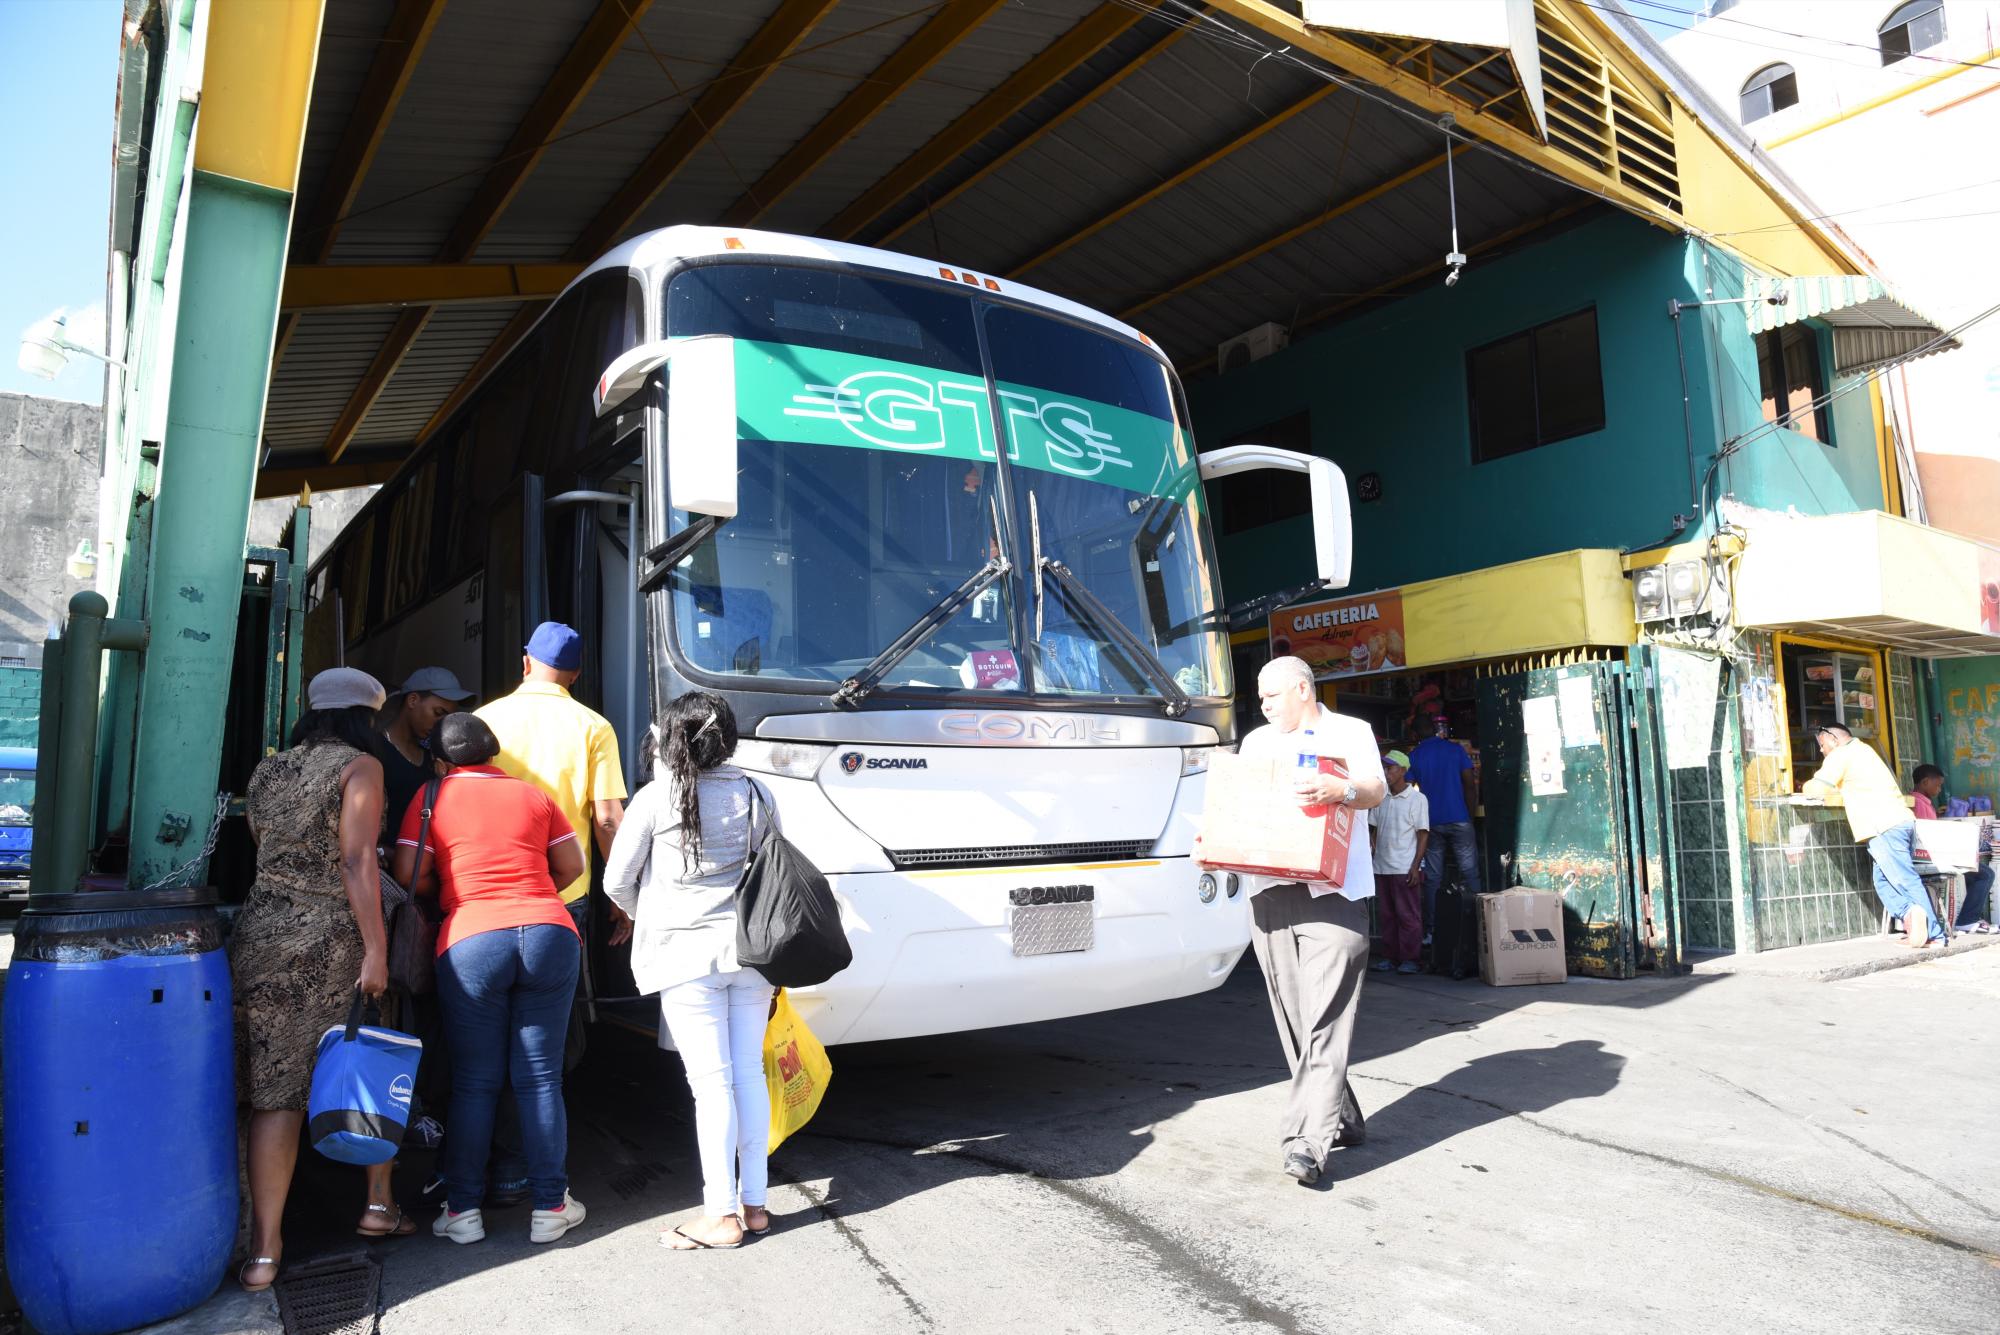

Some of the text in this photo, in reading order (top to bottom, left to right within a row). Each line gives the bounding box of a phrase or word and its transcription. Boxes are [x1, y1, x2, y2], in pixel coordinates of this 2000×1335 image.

[786, 370, 1133, 476] GTS
[1292, 602, 1380, 633] CAFETERIA
[938, 713, 1121, 741] COMIL
[866, 758, 928, 769] SCANIA
